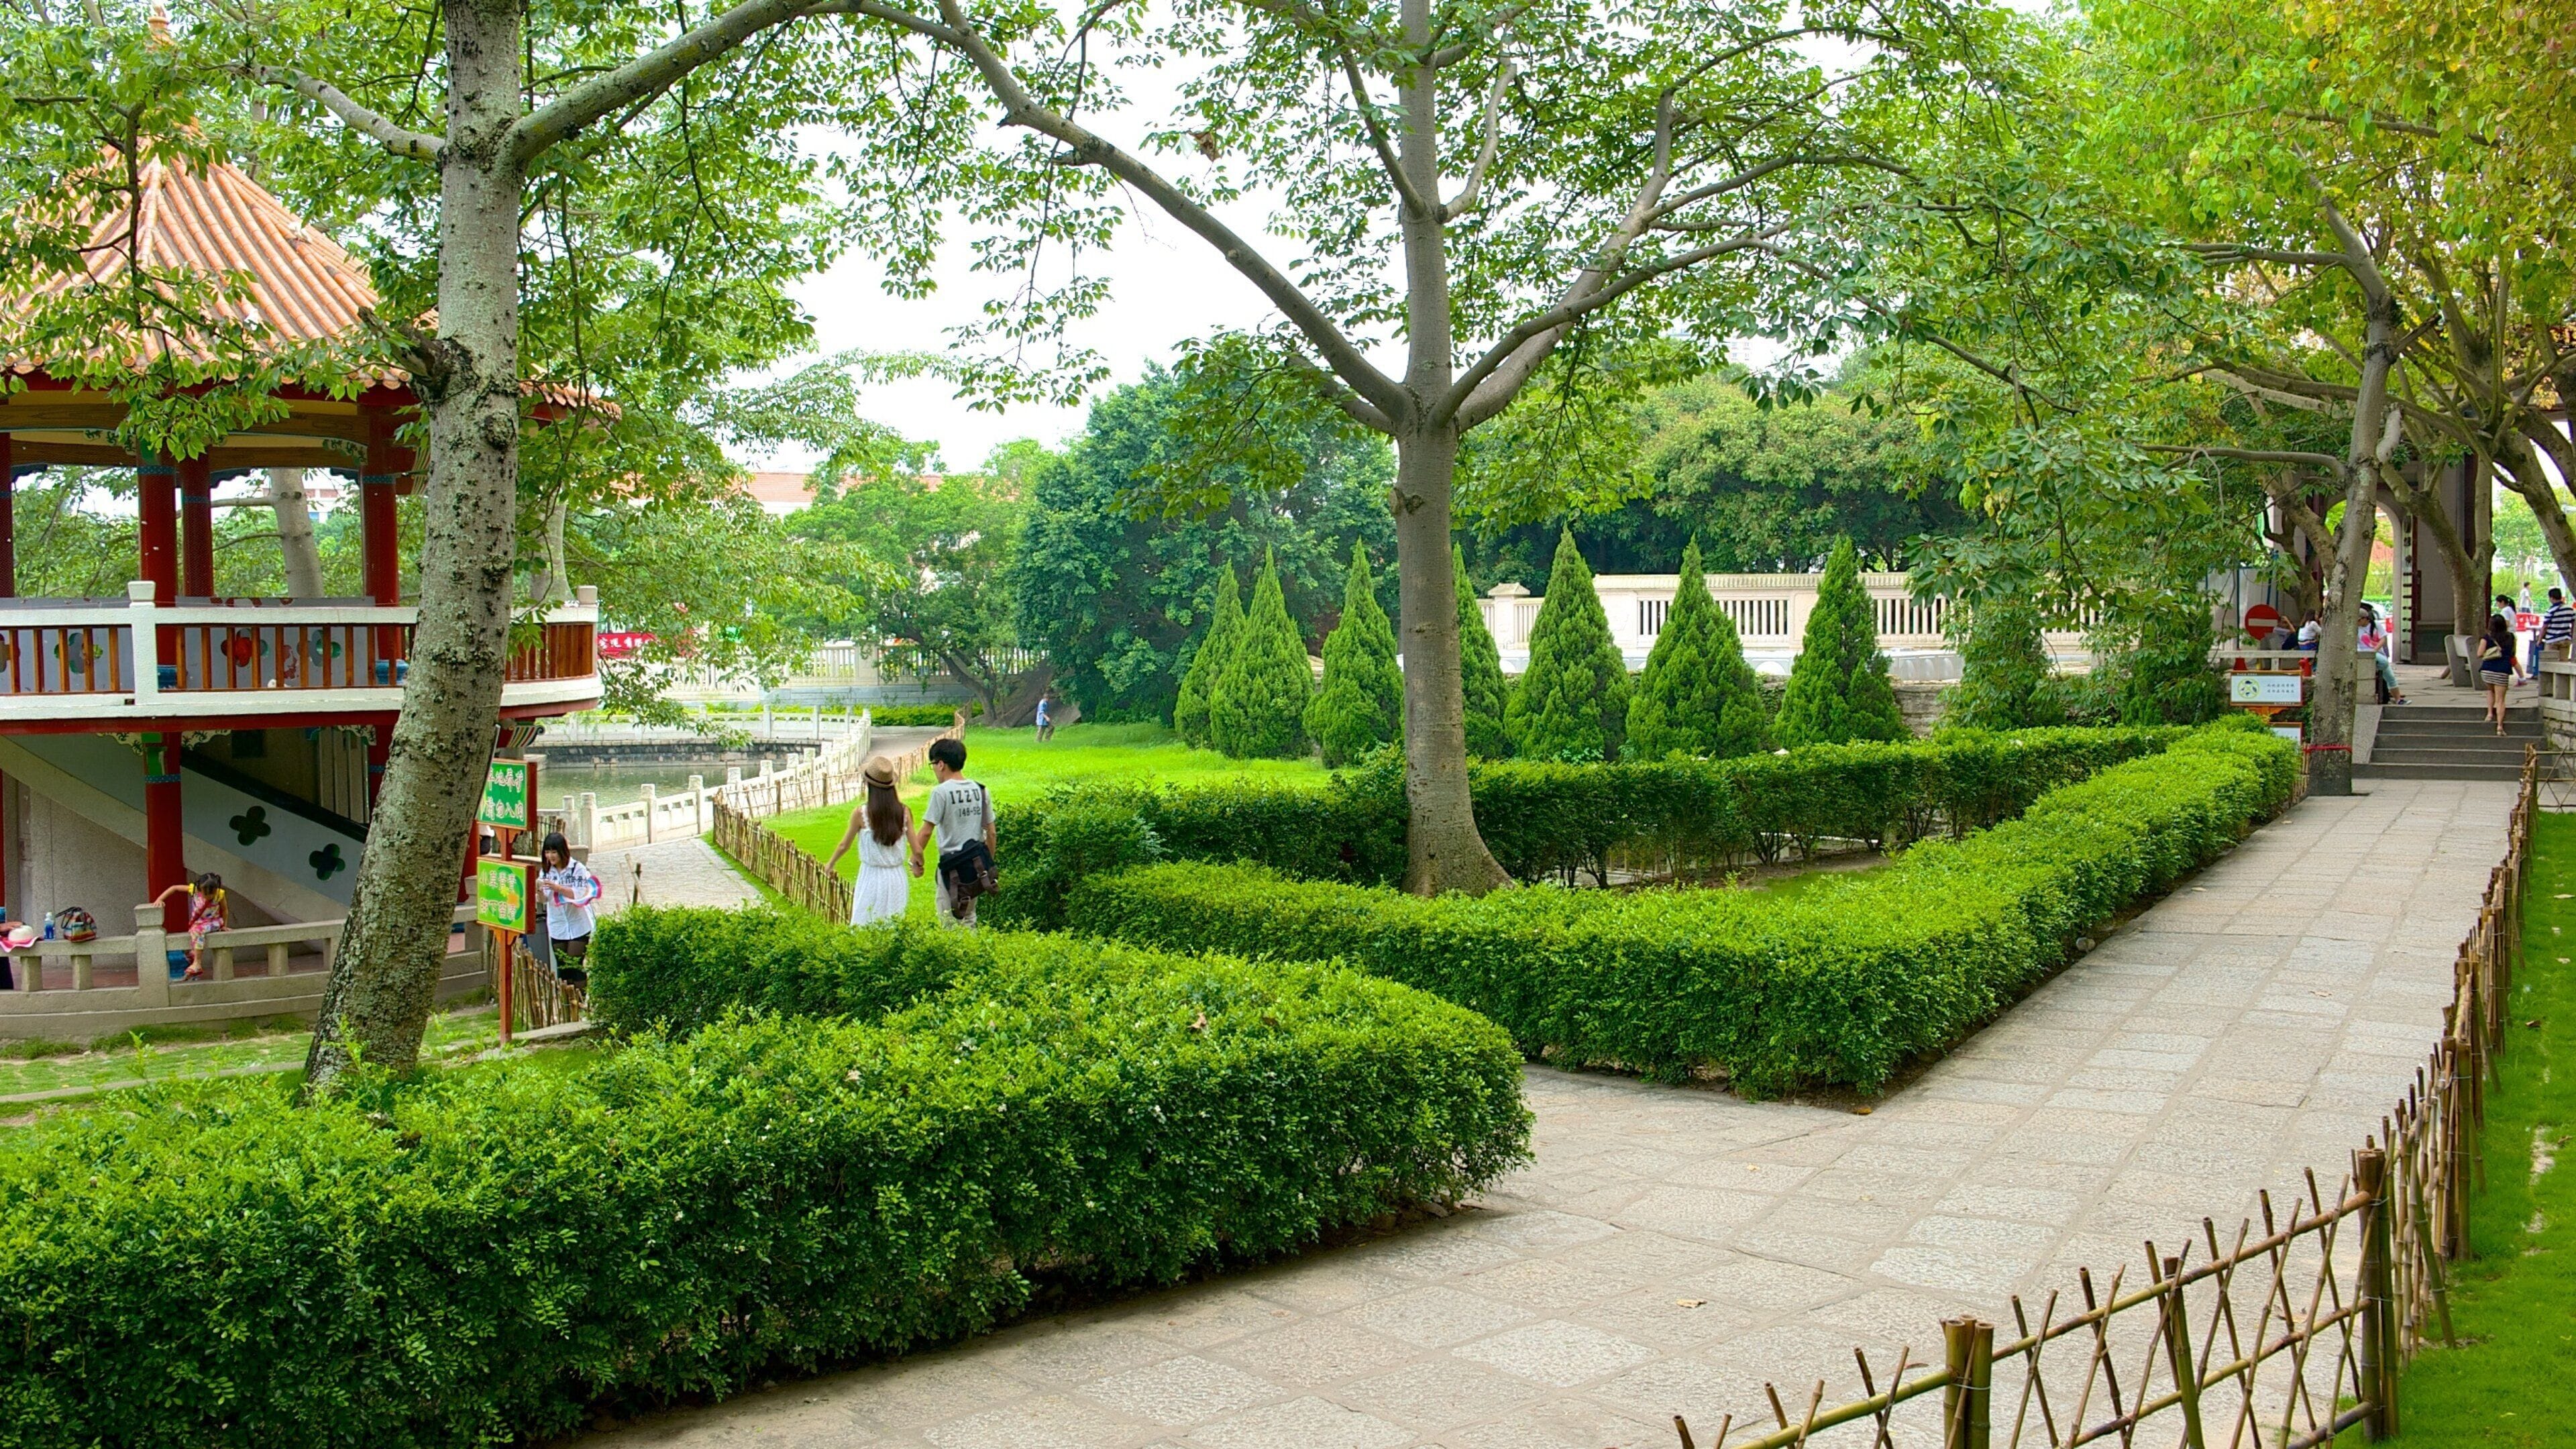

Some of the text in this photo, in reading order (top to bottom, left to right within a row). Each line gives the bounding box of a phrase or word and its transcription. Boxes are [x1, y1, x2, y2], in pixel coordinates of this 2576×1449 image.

[949, 789, 980, 804] IZZU
[485, 796, 523, 822] 请勿入内
